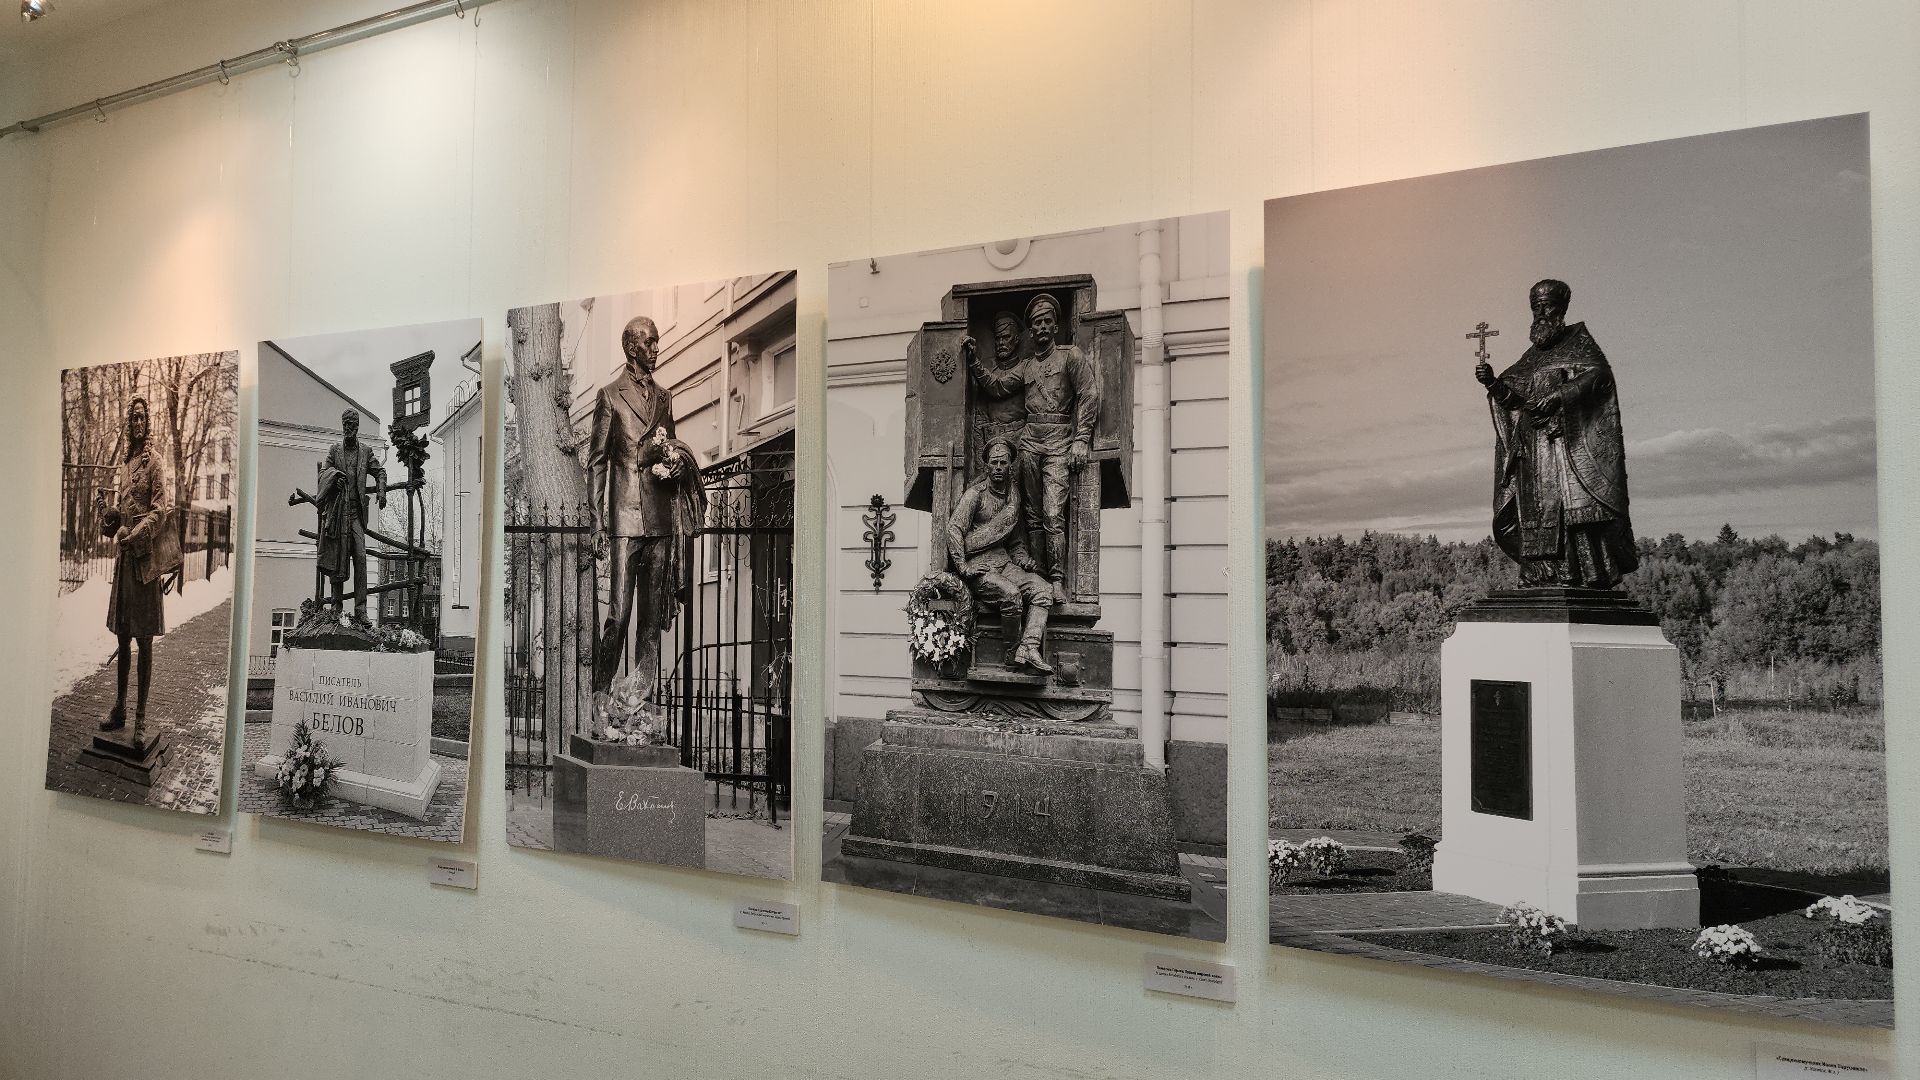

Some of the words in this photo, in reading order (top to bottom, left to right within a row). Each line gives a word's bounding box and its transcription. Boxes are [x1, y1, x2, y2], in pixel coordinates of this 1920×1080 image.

[318, 675, 362, 688] ПИСАТЕЛЬ
[288, 689, 335, 706] ВАСИЛИЙ
[339, 695, 397, 713] ИВАНОВИЧ
[311, 712, 364, 736] БЕЛОВ
[960, 788, 1051, 819] 1914
